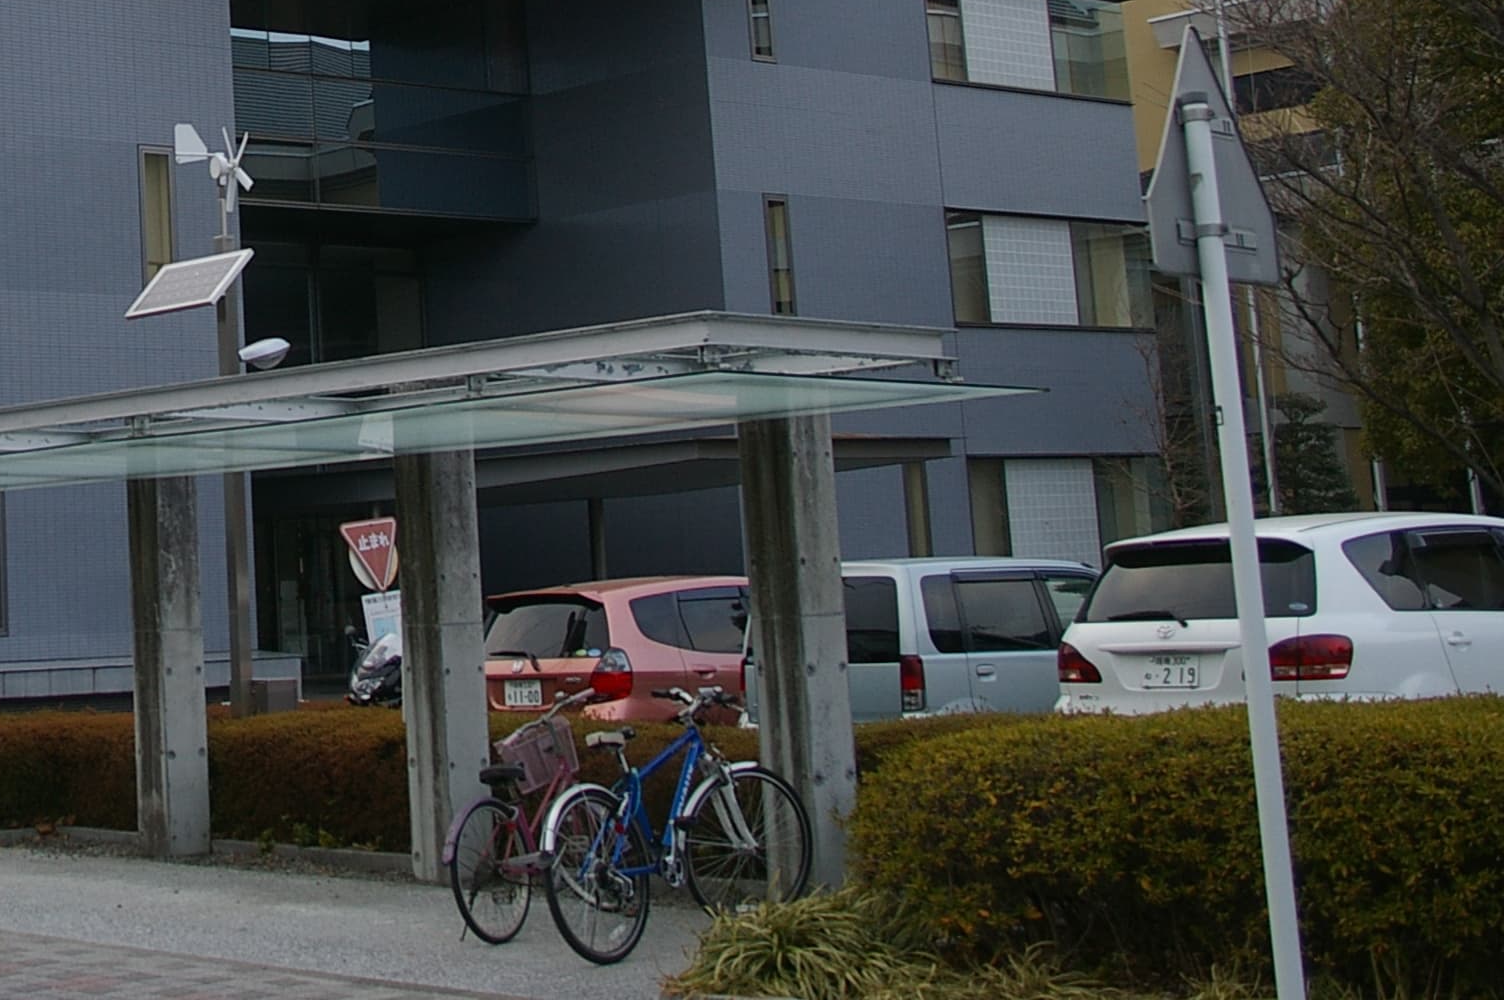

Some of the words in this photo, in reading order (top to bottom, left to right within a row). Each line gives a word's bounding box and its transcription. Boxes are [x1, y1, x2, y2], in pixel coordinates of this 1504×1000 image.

[358, 530, 389, 551] 止まれ
[513, 690, 539, 704] 11-00
